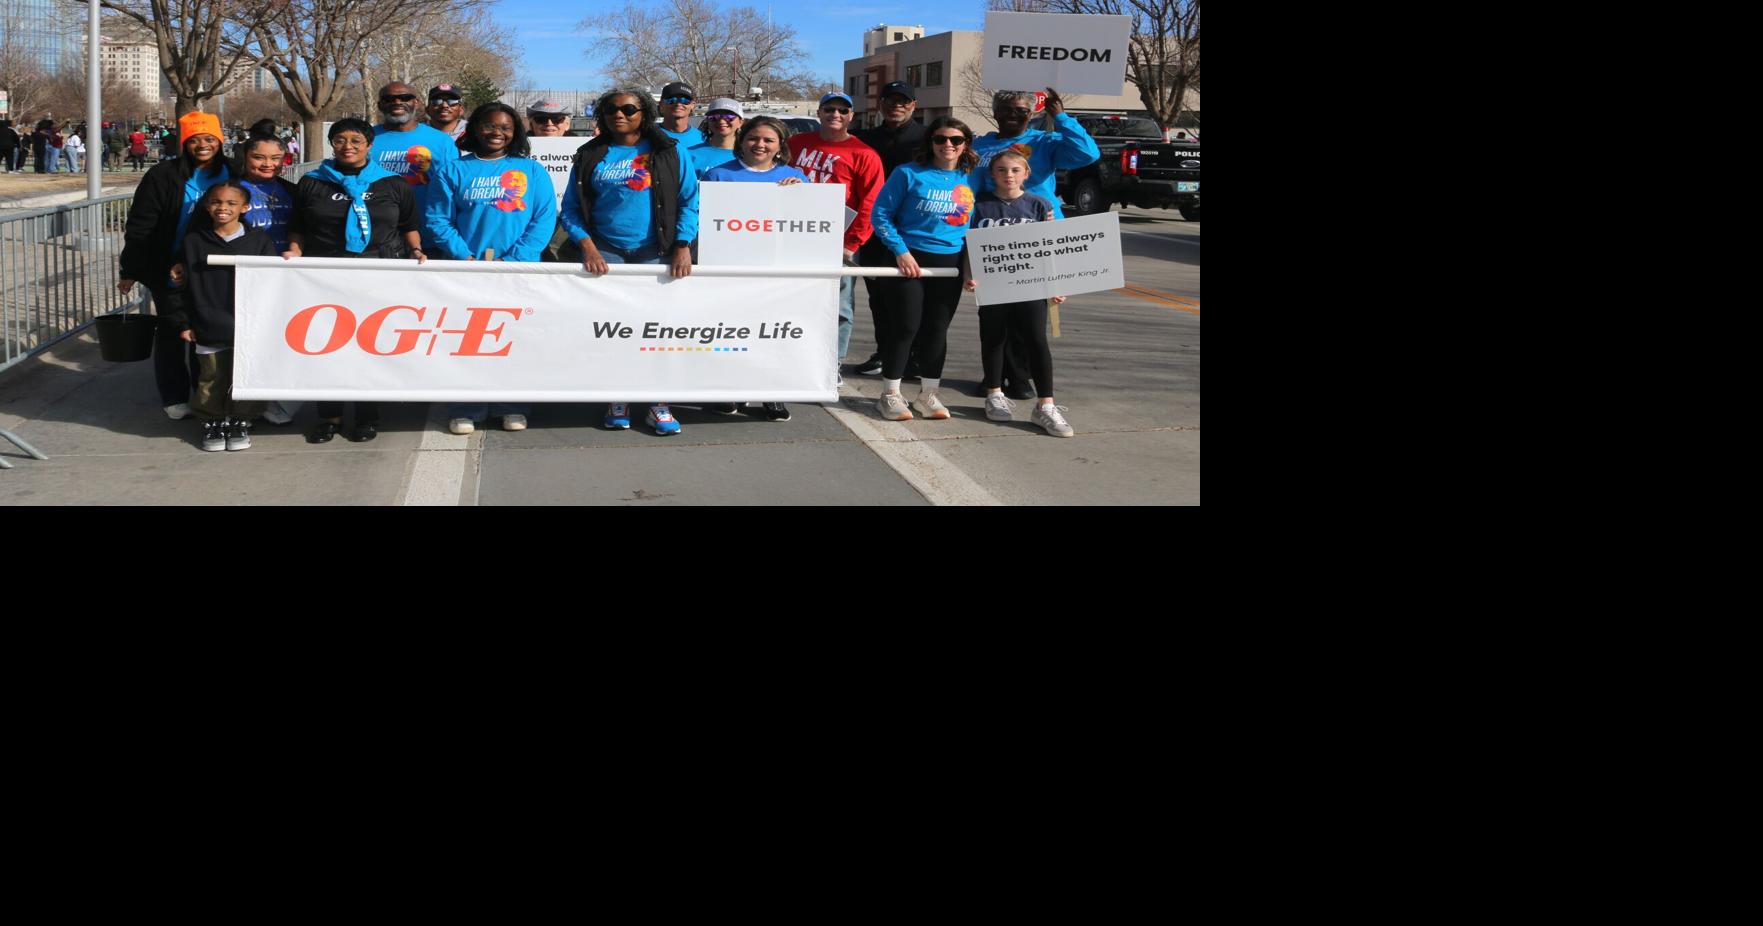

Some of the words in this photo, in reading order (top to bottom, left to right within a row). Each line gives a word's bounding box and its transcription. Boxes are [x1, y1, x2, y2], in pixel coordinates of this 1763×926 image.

[998, 45, 1112, 63] FREEDOM
[385, 151, 408, 162] HAVE
[796, 148, 841, 173] MLK
[471, 177, 478, 188] I
[478, 175, 502, 188] HAVE
[602, 169, 637, 181] DREAM
[463, 189, 469, 199] A
[470, 187, 506, 200] DREAM
[927, 189, 932, 199] I
[933, 189, 954, 200] HAVE
[916, 200, 923, 210] A
[924, 201, 958, 214] DREAM
[713, 218, 831, 233] TOGETHER
[980, 244, 1006, 252] The
[1008, 240, 1040, 250] time
[1042, 237, 1054, 247] is
[1056, 231, 1105, 244] always
[982, 252, 1015, 264] right
[1018, 251, 1031, 260] to
[1034, 249, 1052, 258] do
[1054, 244, 1089, 255] what
[983, 265, 995, 274] is
[998, 262, 1034, 273] right.
[1016, 276, 1046, 285] Martin
[1048, 272, 1076, 282] Luther
[1078, 269, 1098, 278] King
[593, 321, 634, 339] We
[642, 321, 751, 344] Energize
[758, 321, 804, 339] Life
